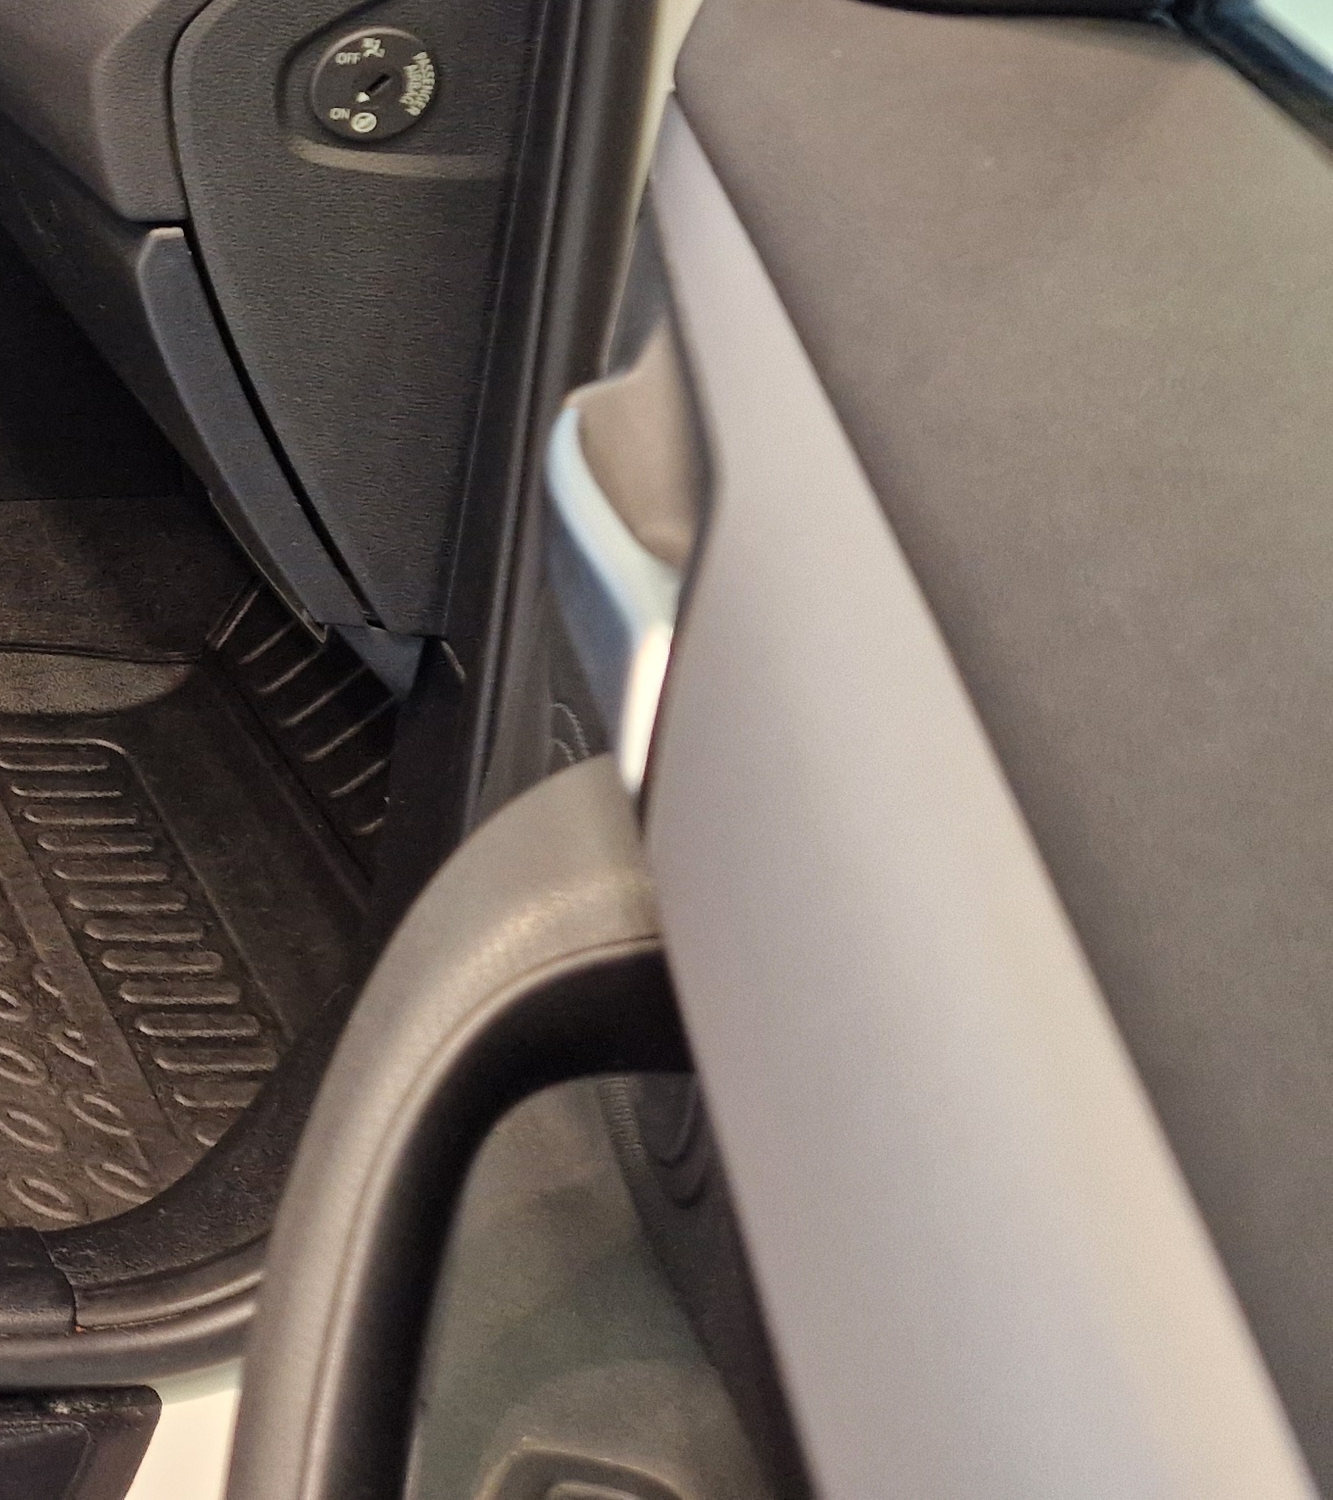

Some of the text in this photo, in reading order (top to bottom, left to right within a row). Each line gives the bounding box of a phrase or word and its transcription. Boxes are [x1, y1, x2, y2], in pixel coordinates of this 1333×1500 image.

[335, 52, 362, 65] OFF
[405, 51, 436, 116] PASSENGER
[329, 107, 351, 120] ON
